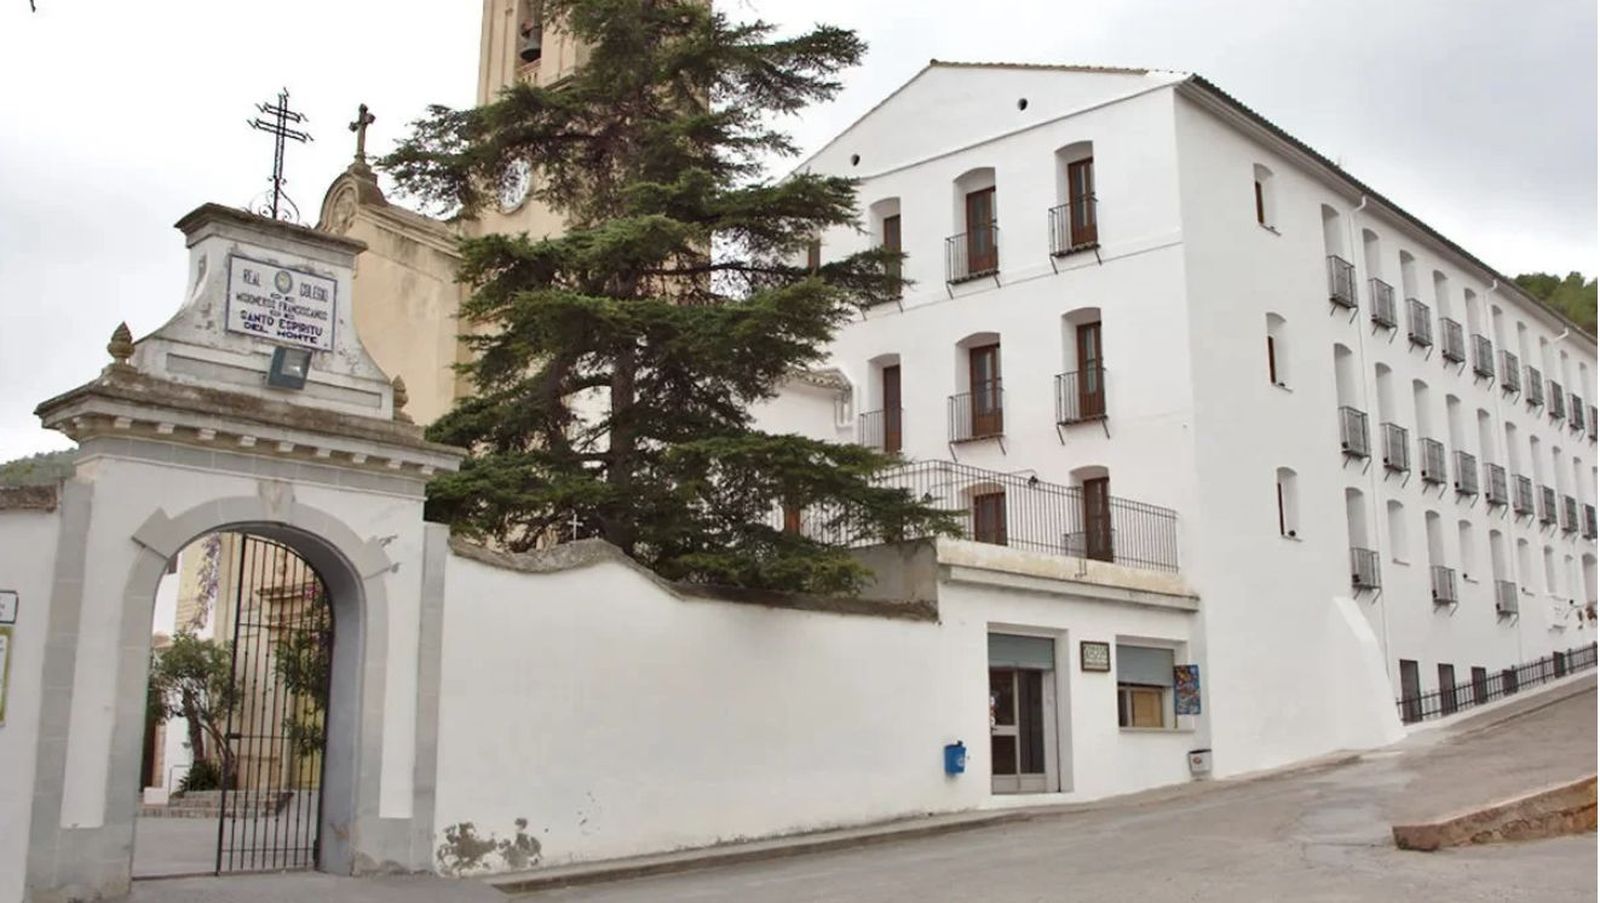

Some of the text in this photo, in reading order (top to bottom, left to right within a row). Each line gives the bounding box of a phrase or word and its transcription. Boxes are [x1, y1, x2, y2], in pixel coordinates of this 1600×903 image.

[240, 309, 324, 337] SANTO ESPIRITU
[243, 321, 318, 344] DEL MONTE
